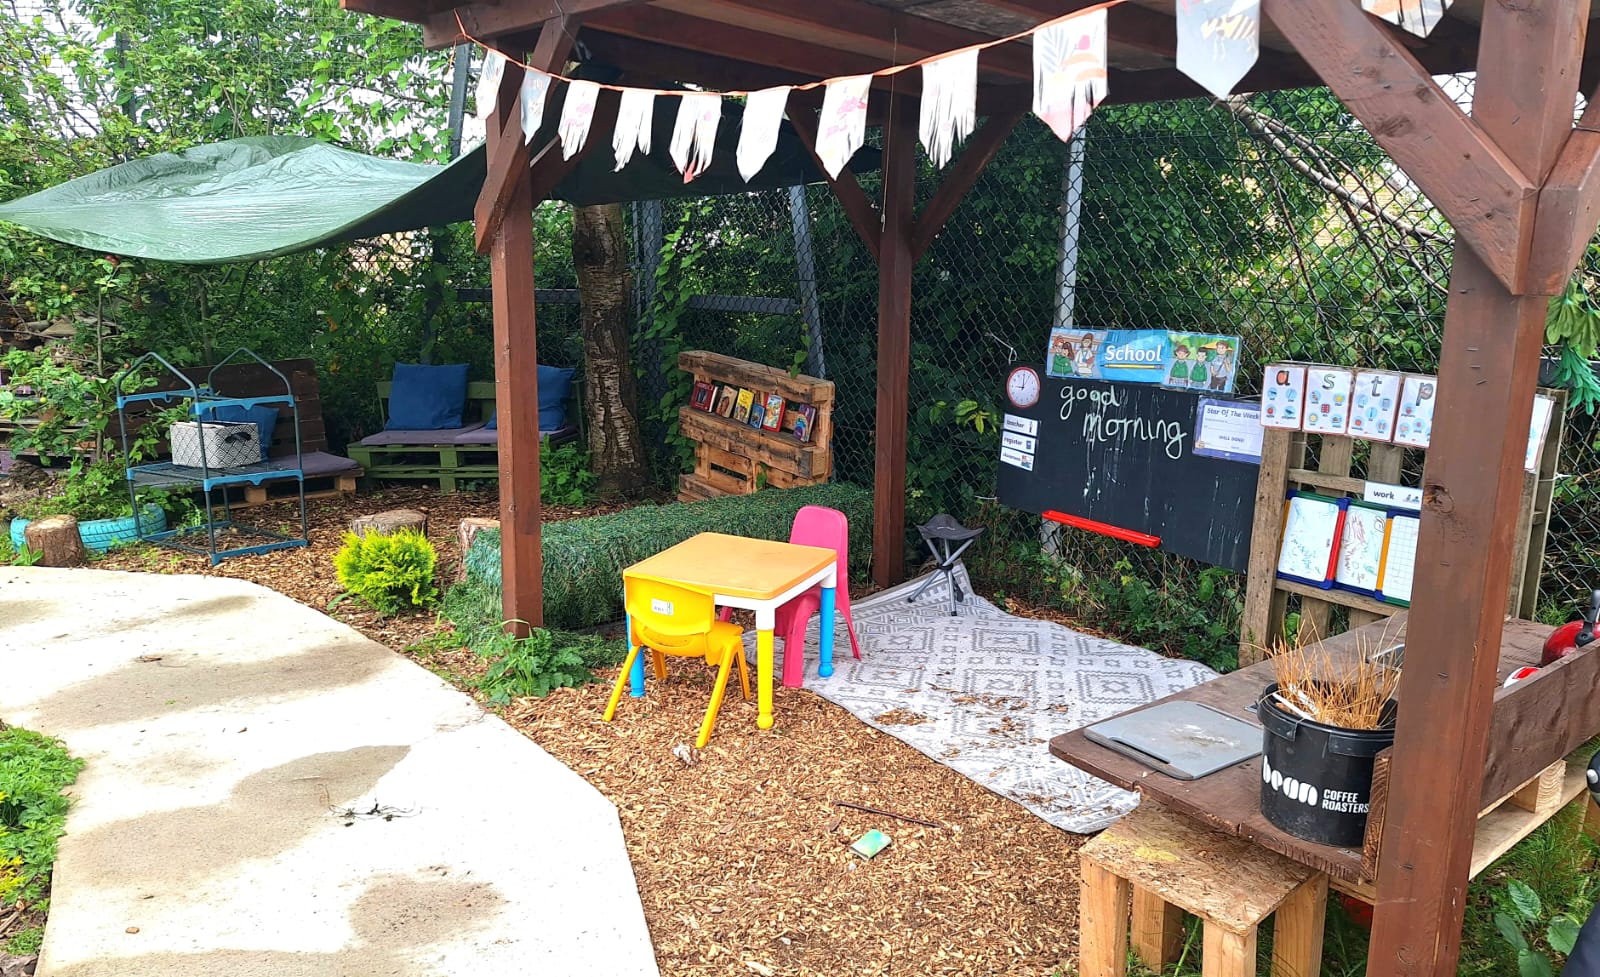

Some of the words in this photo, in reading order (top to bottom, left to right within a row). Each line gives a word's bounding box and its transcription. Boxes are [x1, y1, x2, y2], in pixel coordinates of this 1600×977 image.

[1105, 344, 1162, 362] School
[1276, 370, 1290, 386] a
[1371, 376, 1382, 397] t
[1415, 382, 1433, 406] p
[1060, 385, 1120, 420] good
[1221, 409, 1229, 417] Of
[1006, 420, 1024, 428] teacher
[1004, 437, 1022, 445] register
[1373, 490, 1395, 500] work
[1323, 789, 1359, 803] COFFEE
[1321, 799, 1370, 814] ROASTERS
